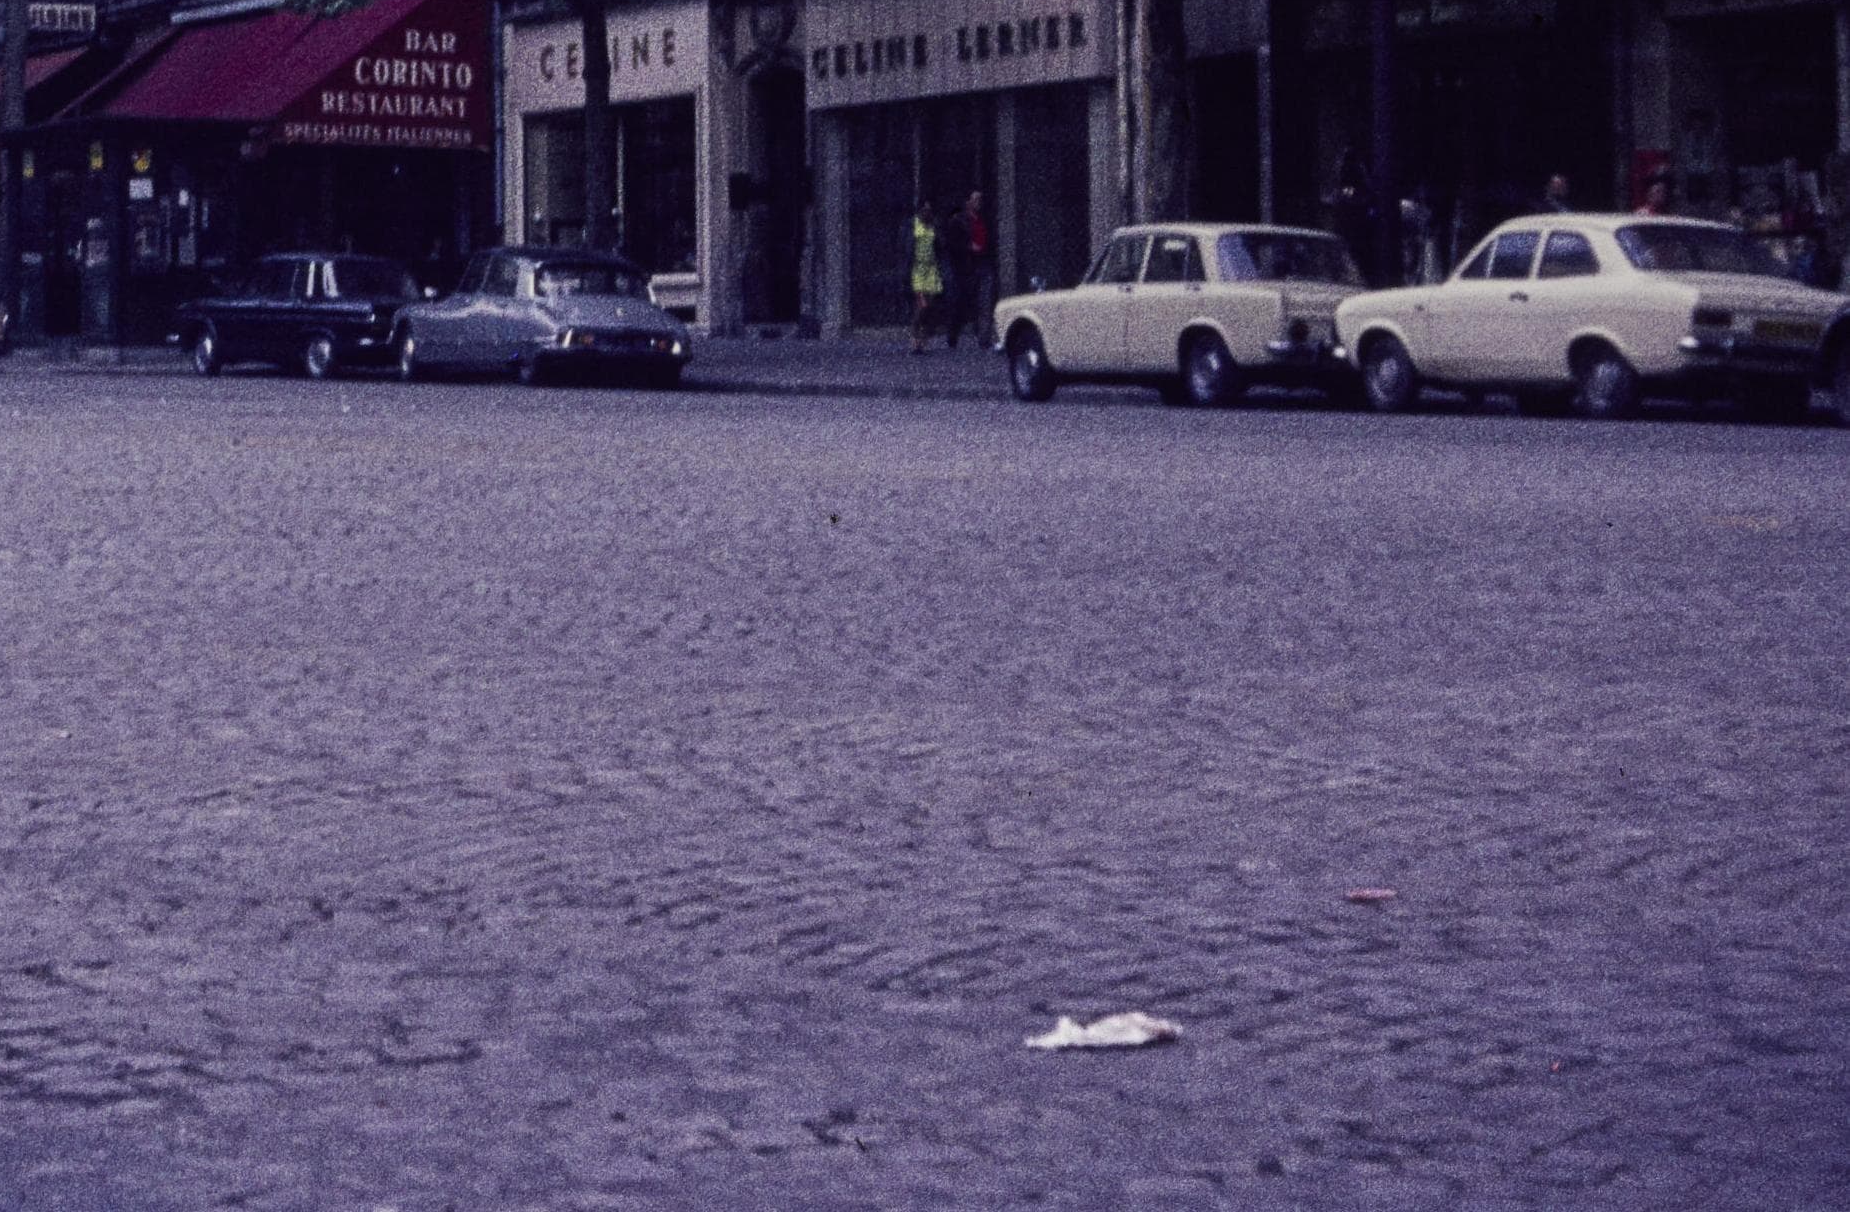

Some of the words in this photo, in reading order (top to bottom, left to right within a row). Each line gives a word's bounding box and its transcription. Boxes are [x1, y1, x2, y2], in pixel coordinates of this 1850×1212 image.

[405, 29, 456, 53] BAR
[540, 27, 675, 83] CEINE
[811, 34, 927, 79] CELINE
[355, 57, 472, 89] CORINTO
[321, 91, 466, 118] RESTAURANT
